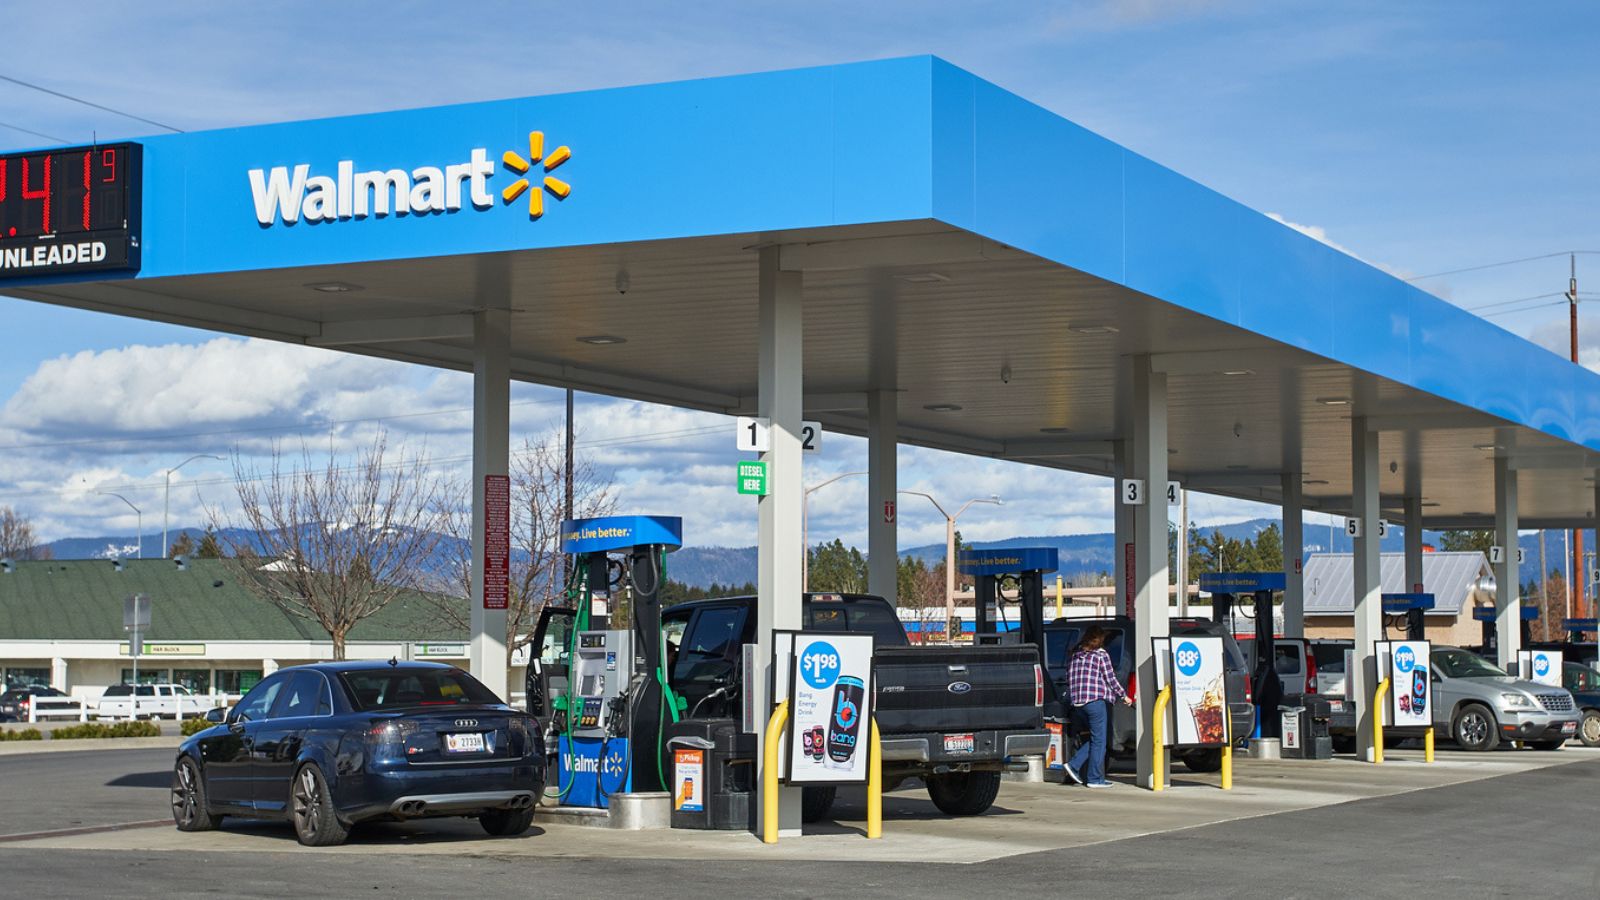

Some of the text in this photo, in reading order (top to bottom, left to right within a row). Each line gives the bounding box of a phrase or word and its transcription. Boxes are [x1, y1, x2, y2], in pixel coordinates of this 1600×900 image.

[248, 148, 494, 225] Walmart
[748, 422, 757, 446] 1
[802, 426, 815, 450] 2
[740, 465, 764, 477] DIESEL
[744, 479, 760, 491] HERE
[1128, 483, 1137, 501] 3
[1167, 485, 1176, 502] 4
[582, 528, 597, 540] Live
[1349, 520, 1356, 534] 5
[1493, 548, 1500, 560] 7
[831, 730, 856, 747] bang
[564, 753, 609, 773] Walmat
